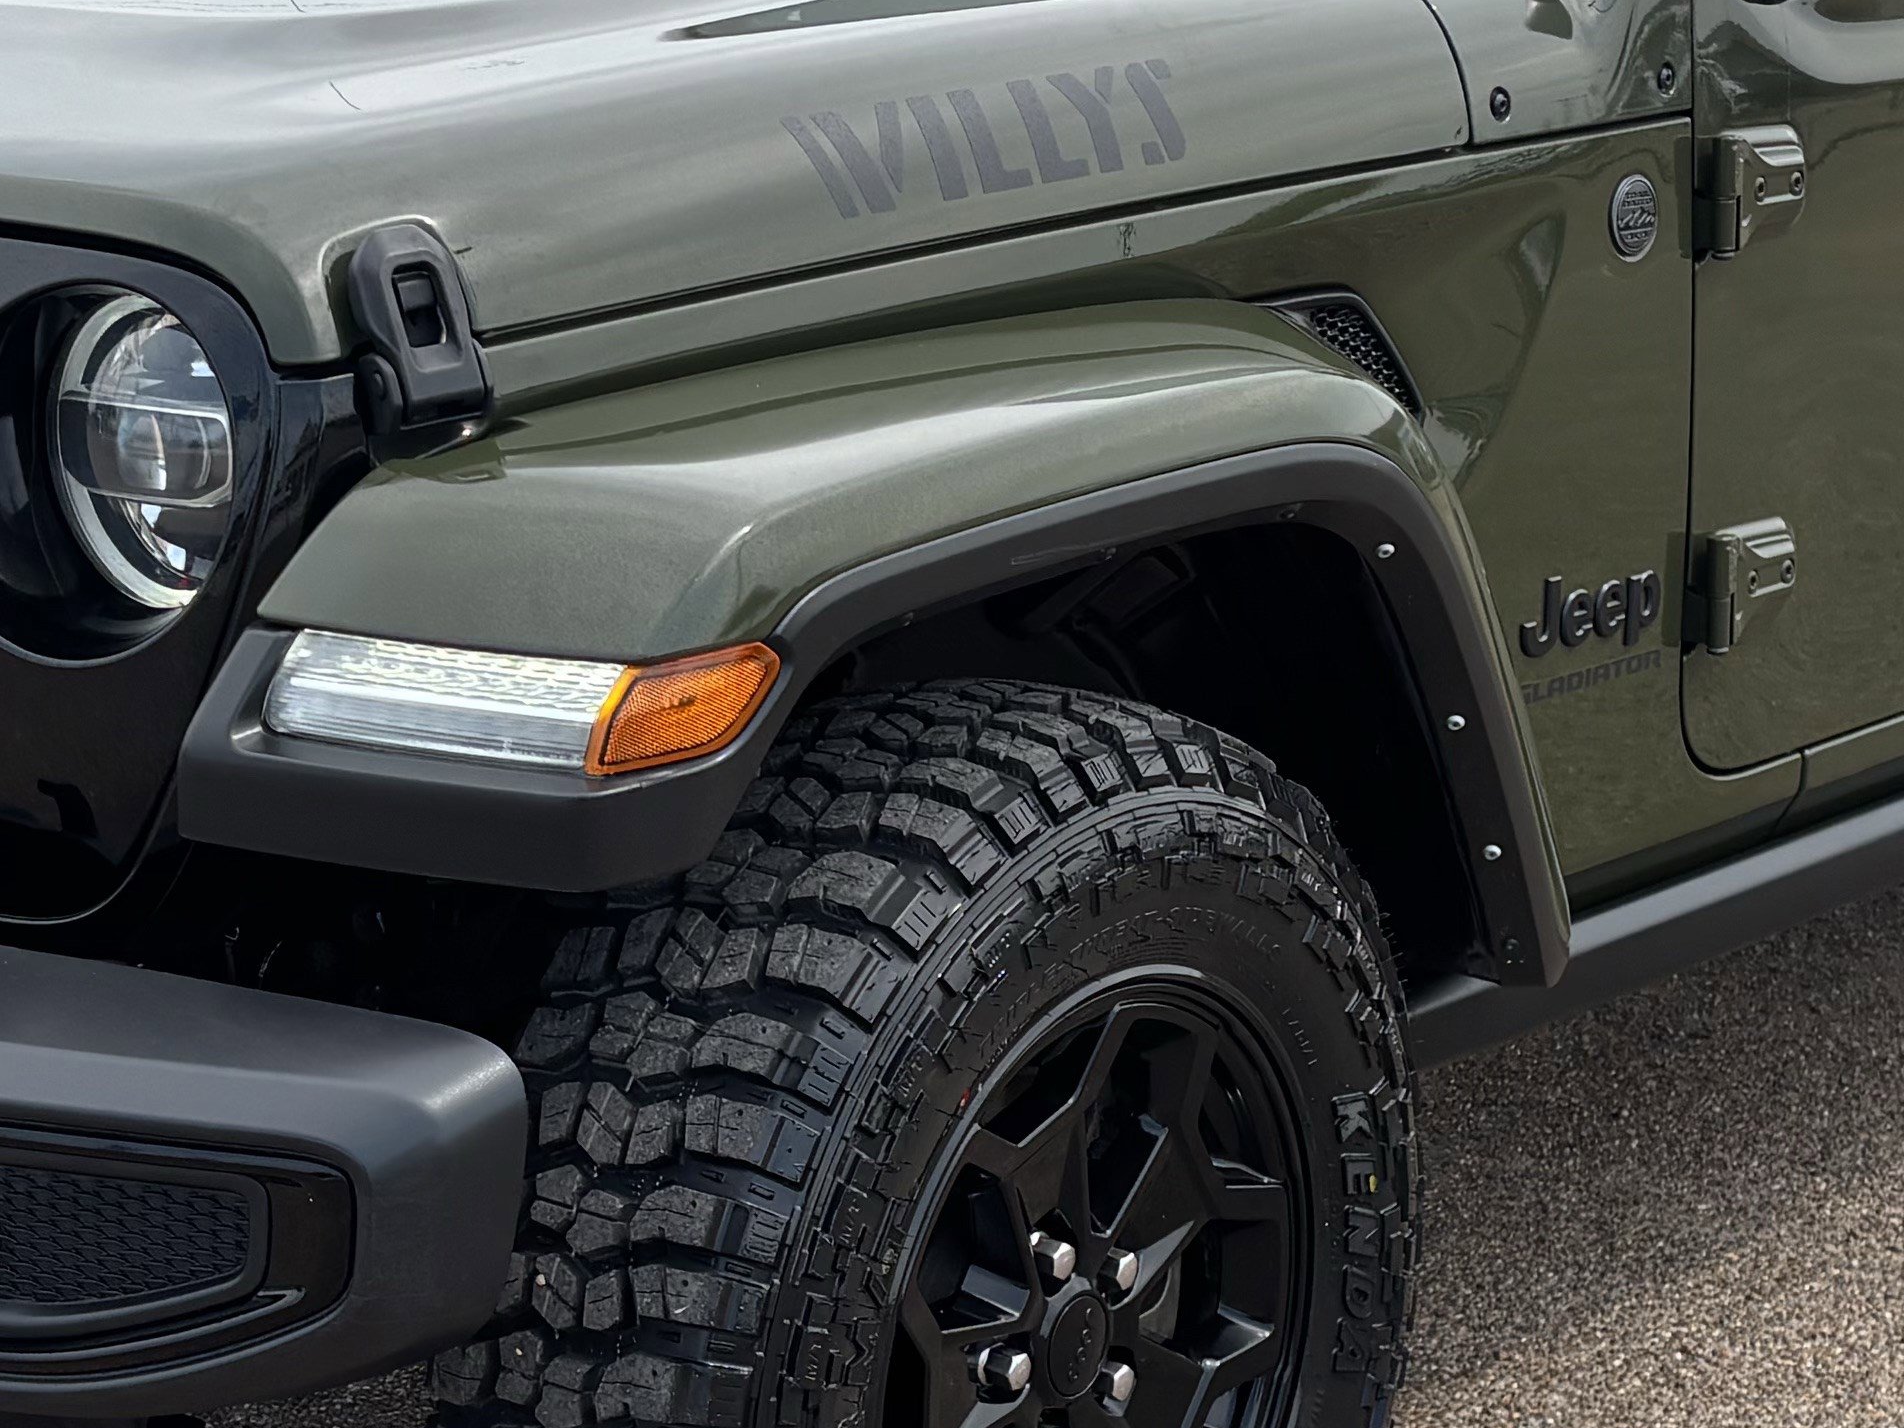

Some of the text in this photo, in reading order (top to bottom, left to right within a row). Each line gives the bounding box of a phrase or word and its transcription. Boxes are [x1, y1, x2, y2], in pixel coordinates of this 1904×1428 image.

[778, 58, 1187, 220] WILLYS
[1519, 569, 1662, 658] Jeep
[1520, 649, 1662, 706] GLADIATOR
[1331, 1091, 1380, 1372] KENDA
